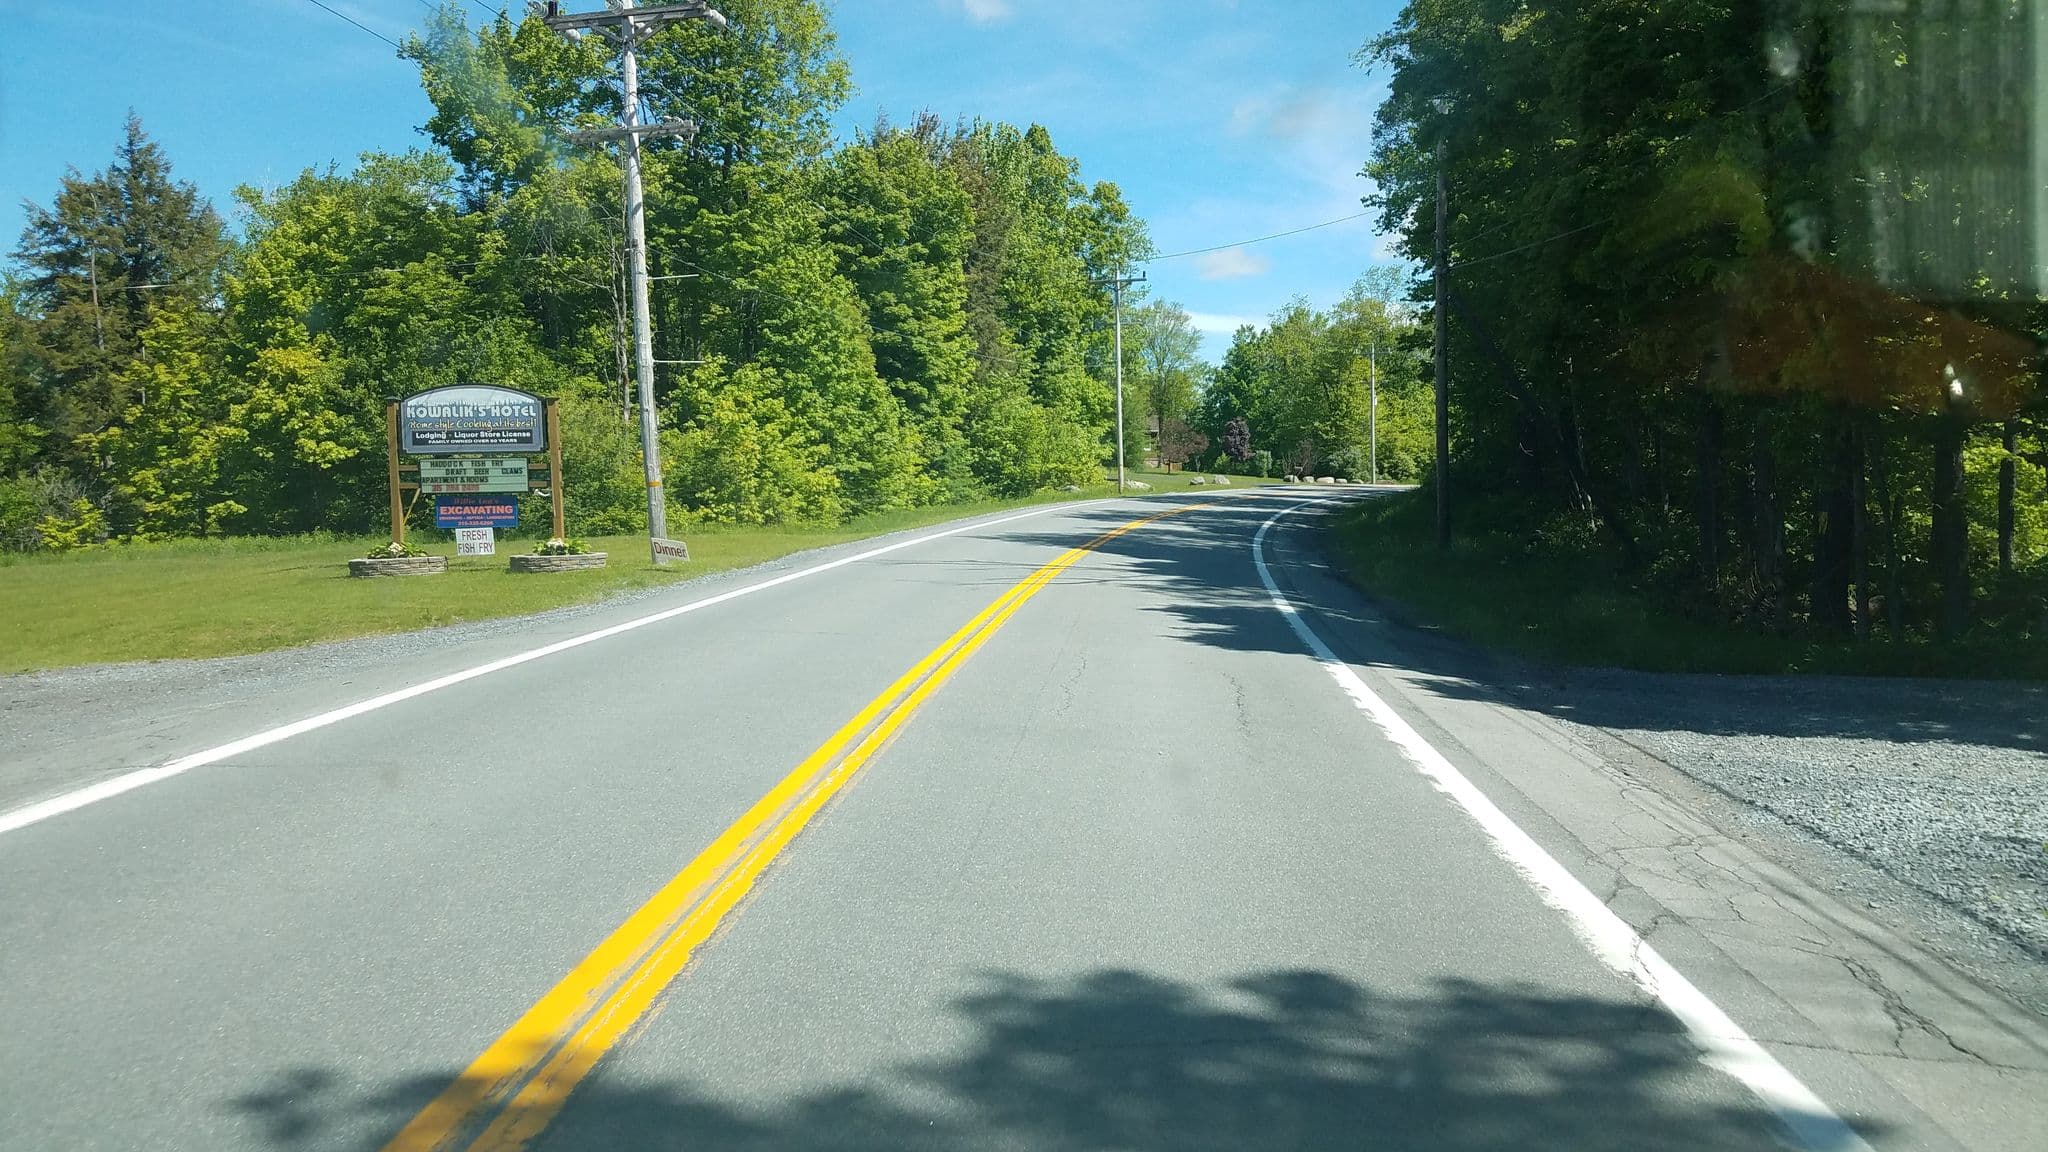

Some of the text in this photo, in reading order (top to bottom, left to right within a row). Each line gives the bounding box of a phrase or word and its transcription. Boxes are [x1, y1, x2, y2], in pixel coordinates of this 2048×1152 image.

[406, 405, 537, 418] KOWALIK'S HOTEL
[408, 419, 433, 429] Home
[434, 418, 455, 433] style
[456, 418, 493, 432] Cooking
[415, 430, 531, 440] Lodging Liquor Store License
[430, 460, 464, 468] HADDOCK
[501, 467, 524, 475] CLAMS
[440, 505, 514, 515] EXCAVATING
[461, 530, 488, 541] FRESH
[458, 541, 494, 554] FISH FRY
[653, 541, 688, 558] Dinner
